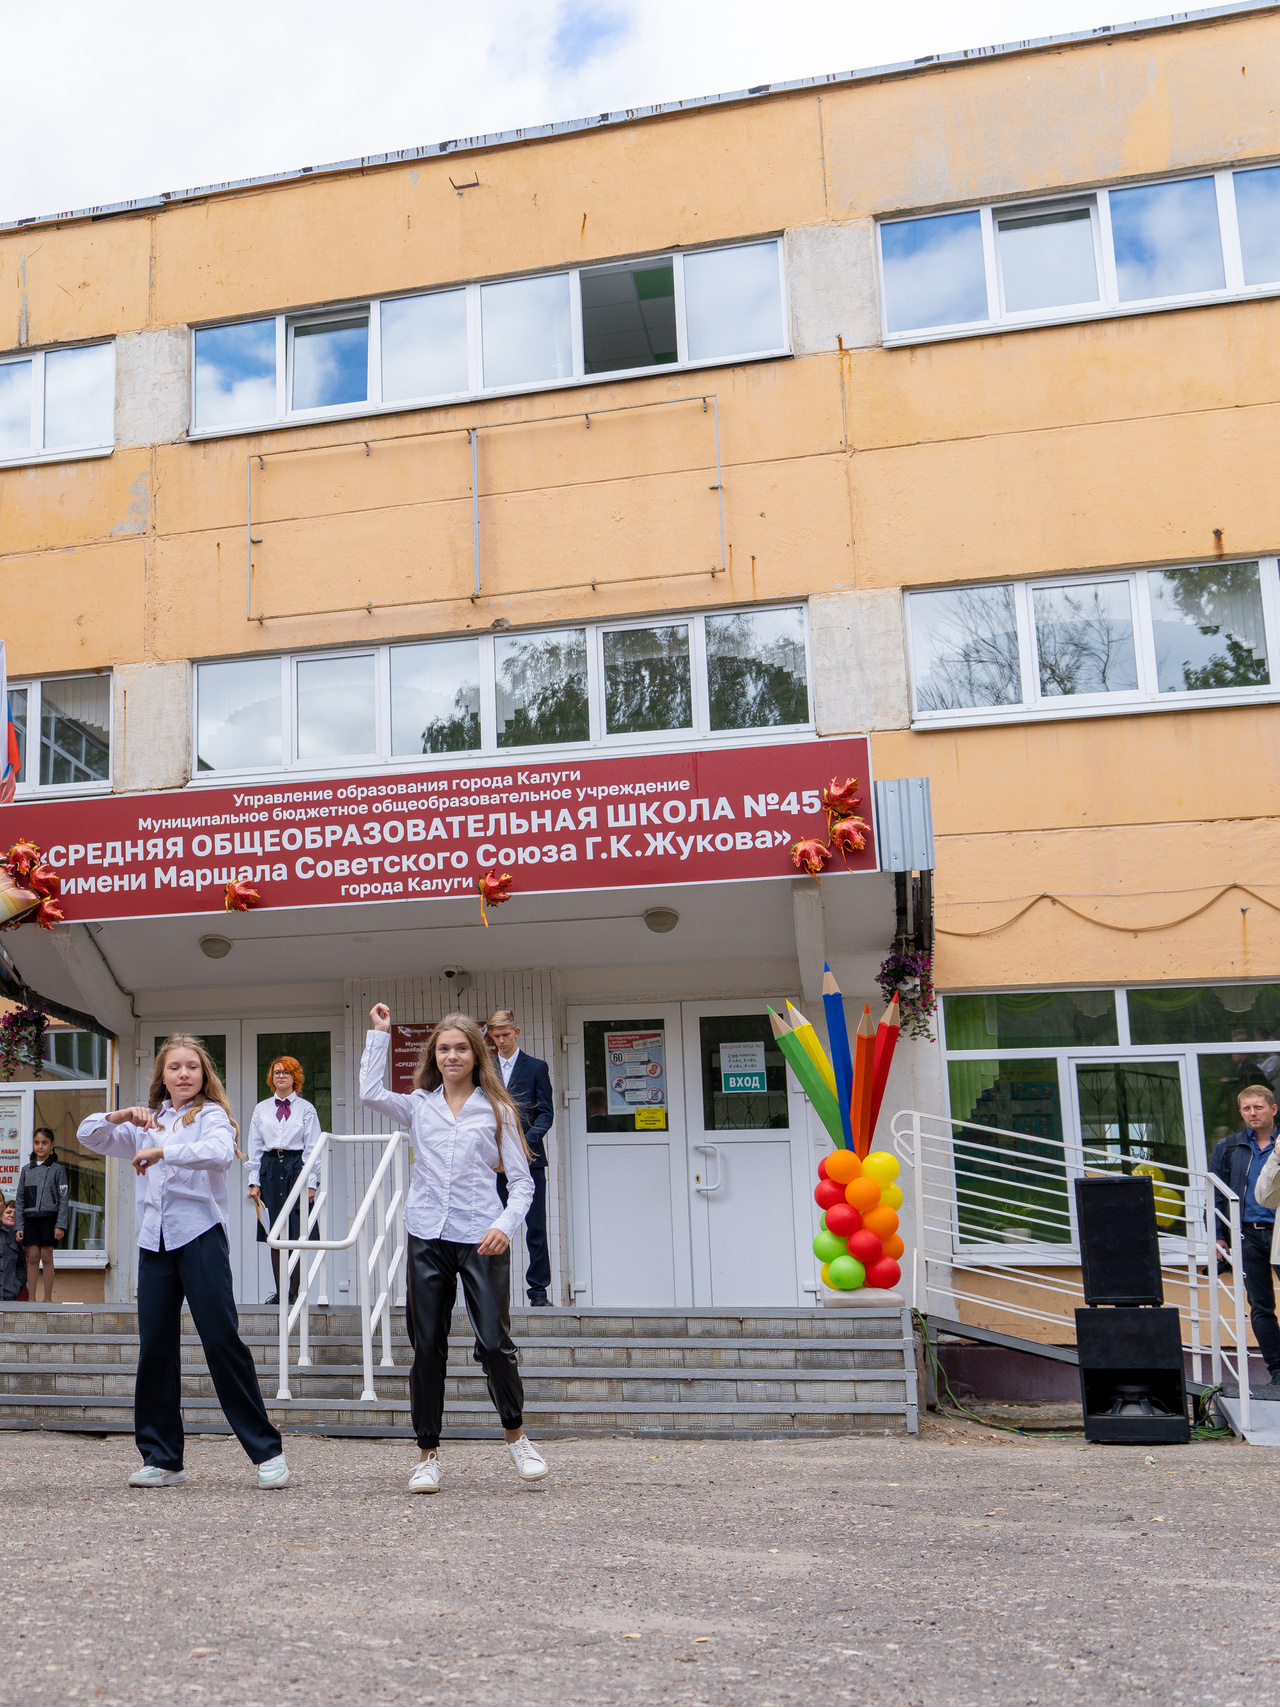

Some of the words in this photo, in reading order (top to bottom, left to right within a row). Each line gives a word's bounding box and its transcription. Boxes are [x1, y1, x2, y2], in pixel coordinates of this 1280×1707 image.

[138, 811, 269, 834] Муниципальное
[272, 803, 369, 822] бюджетное
[371, 788, 573, 814] общеобразовательное
[575, 779, 691, 802] учреждение
[232, 789, 333, 808] Управление
[336, 780, 449, 801] образования
[452, 776, 513, 792] города
[517, 770, 581, 786] Калуги
[191, 805, 598, 857] ОБЩЕОБРАЗОВАТЕЛЬНАЯ
[606, 796, 736, 828] ШКОЛА
[743, 789, 822, 819] №45
[60, 872, 147, 896] имени
[154, 862, 288, 892] Маршала
[294, 850, 469, 880] Советского
[476, 843, 578, 868] Союза
[585, 829, 792, 861] Г.К.Жукова»
[340, 881, 404, 899] города
[407, 876, 474, 894] Калуги
[613, 1052, 623, 1062] 60
[729, 1076, 760, 1089] ВХОД
